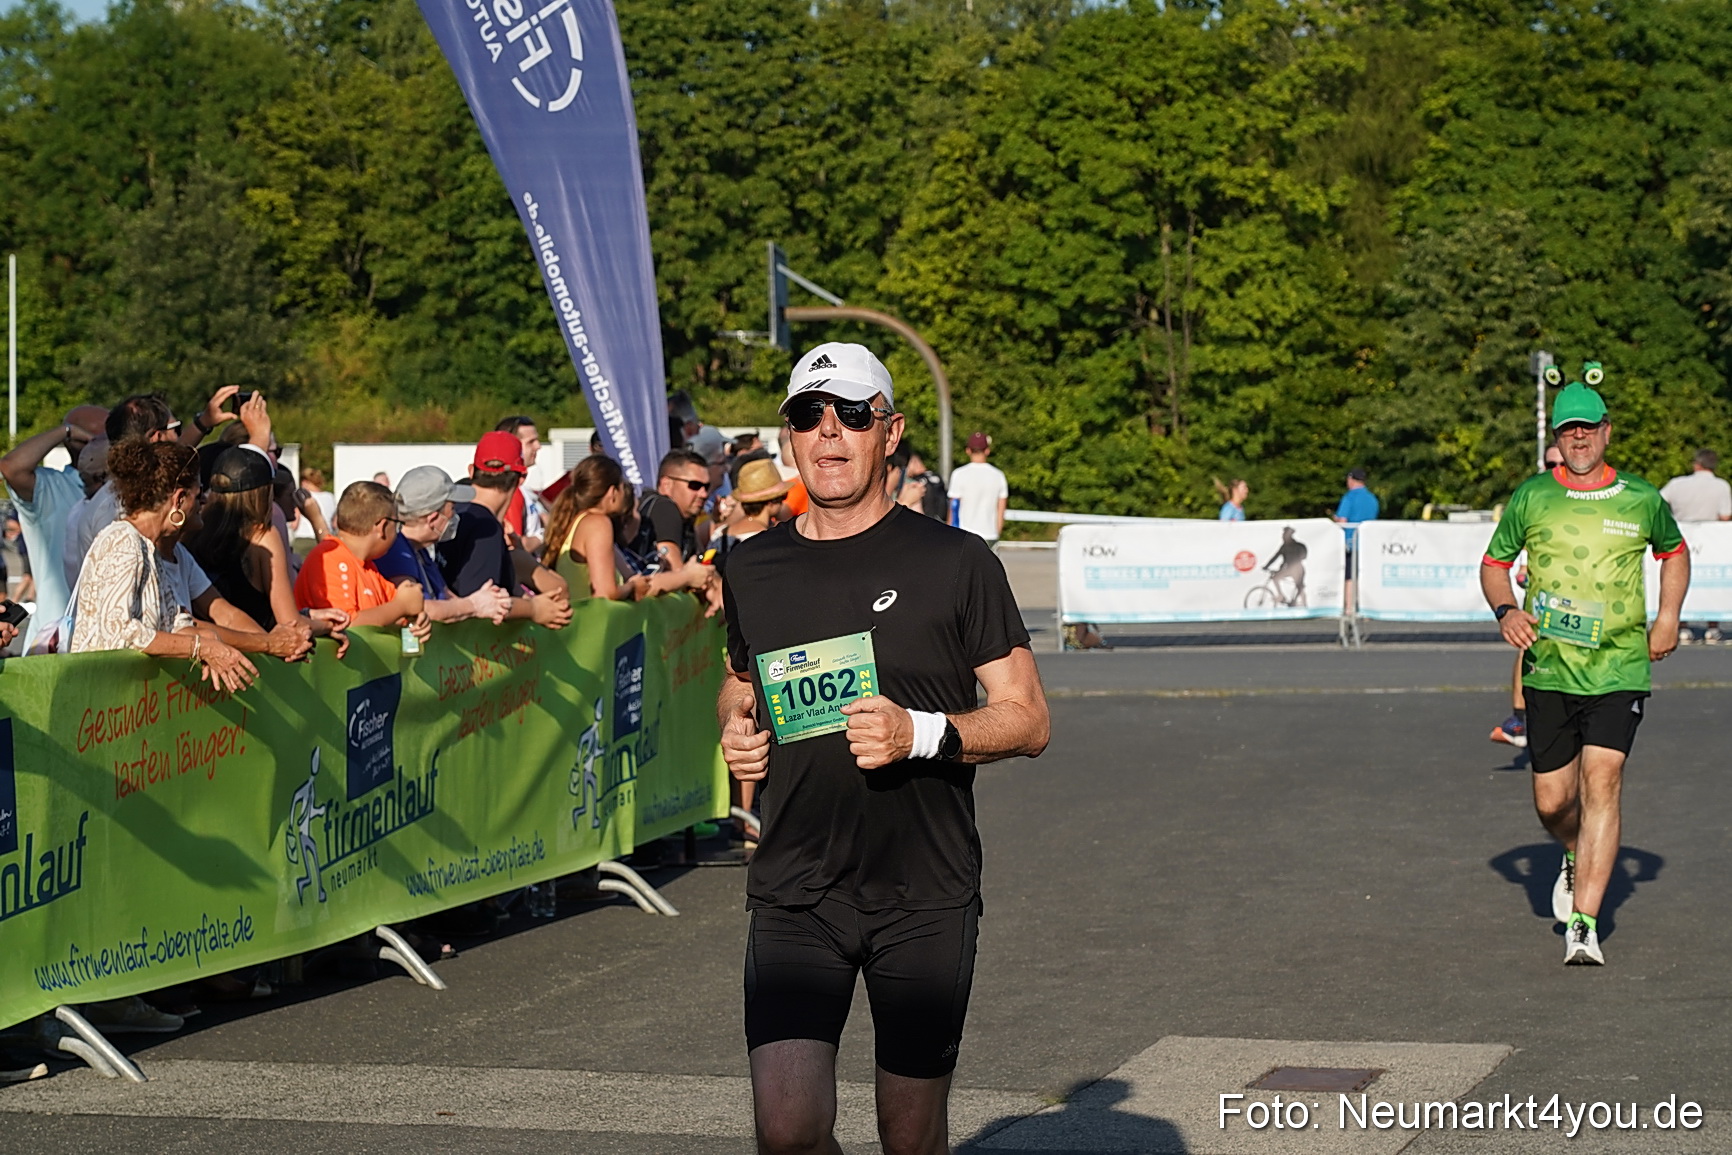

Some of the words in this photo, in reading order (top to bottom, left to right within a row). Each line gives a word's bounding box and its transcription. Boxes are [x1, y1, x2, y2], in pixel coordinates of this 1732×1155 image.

[808, 363, 838, 373] adidas
[1083, 545, 1118, 557] NOW
[1382, 543, 1417, 555] NOW
[1560, 613, 1582, 630] 43
[786, 658, 821, 673] Firmenlauf
[781, 668, 859, 711] 1062
[77, 679, 159, 752] Gesunde
[770, 694, 785, 726] RUN
[784, 712, 805, 724] Lazar
[806, 706, 826, 718] Vlad
[357, 711, 389, 740] Fischer
[115, 739, 171, 800] laufen
[176, 707, 247, 780] länger!
[323, 748, 441, 864] firmenlauf
[330, 850, 378, 892] neumarkt
[34, 904, 255, 992] www.firmenlauf-oberpfalz.de
